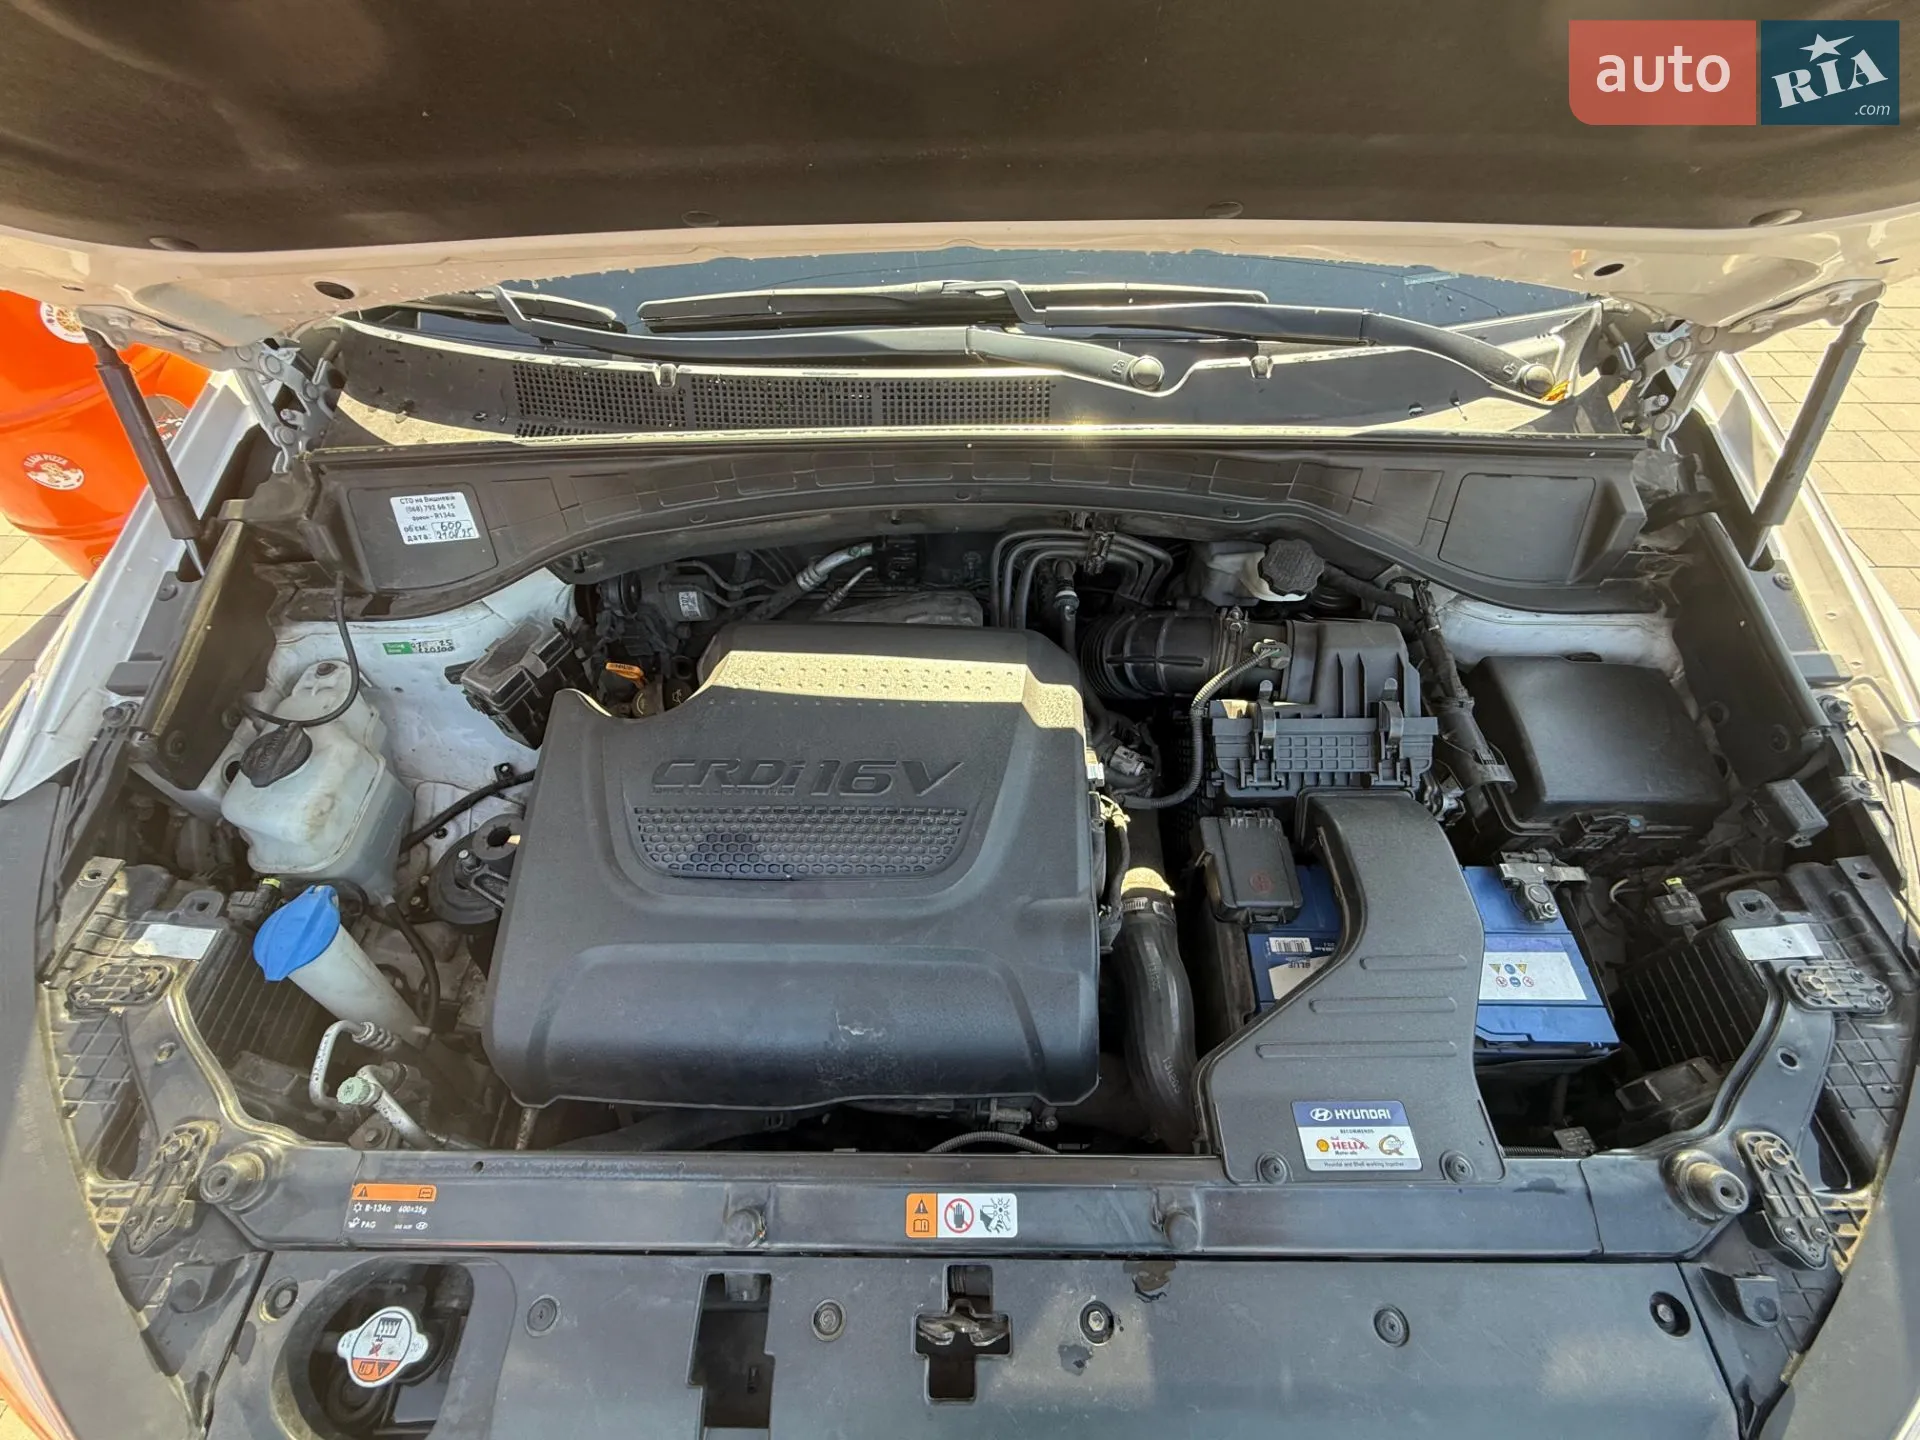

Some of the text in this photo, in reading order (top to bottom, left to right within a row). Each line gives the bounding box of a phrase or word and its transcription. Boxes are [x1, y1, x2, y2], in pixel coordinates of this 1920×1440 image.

[399, 497, 414, 505] СТО
[440, 521, 462, 531] 600
[407, 534, 432, 542] дата:
[651, 757, 965, 796] CRDi 16V
[1334, 1108, 1392, 1120] HYUNDAI
[1331, 1141, 1367, 1150] HELIX
[360, 1220, 377, 1229] PAG
